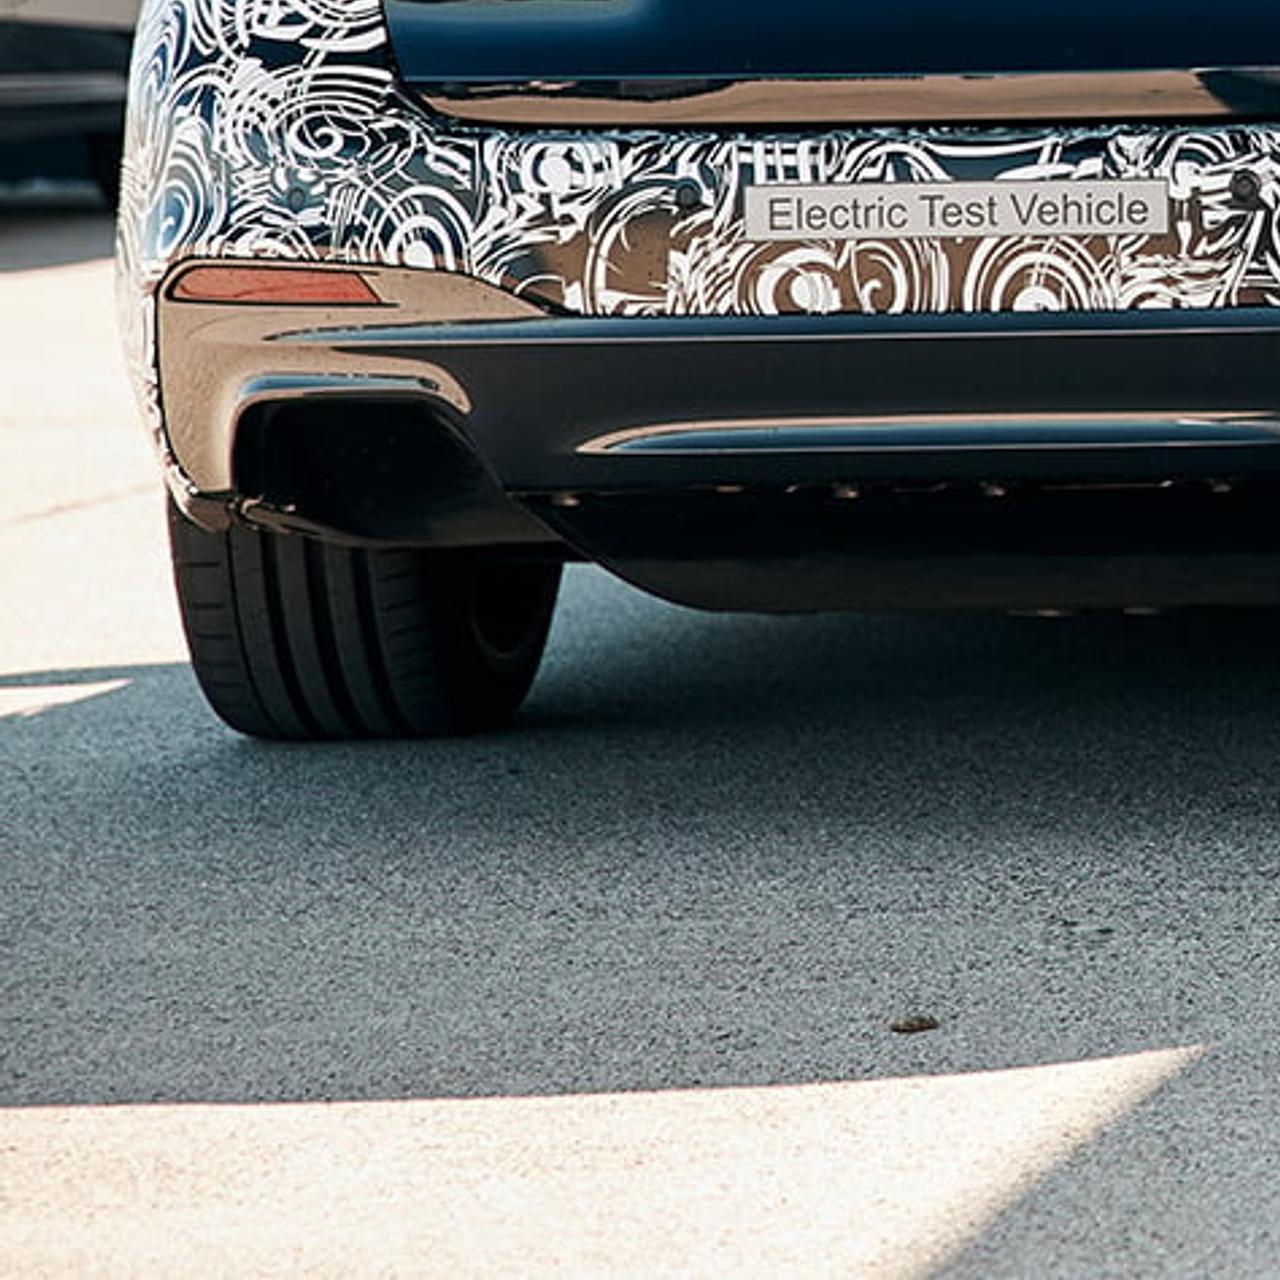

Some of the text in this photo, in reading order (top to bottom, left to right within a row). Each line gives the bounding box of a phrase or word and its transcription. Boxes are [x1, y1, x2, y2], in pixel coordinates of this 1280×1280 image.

[768, 191, 1149, 231] Electric Test Vehicle
